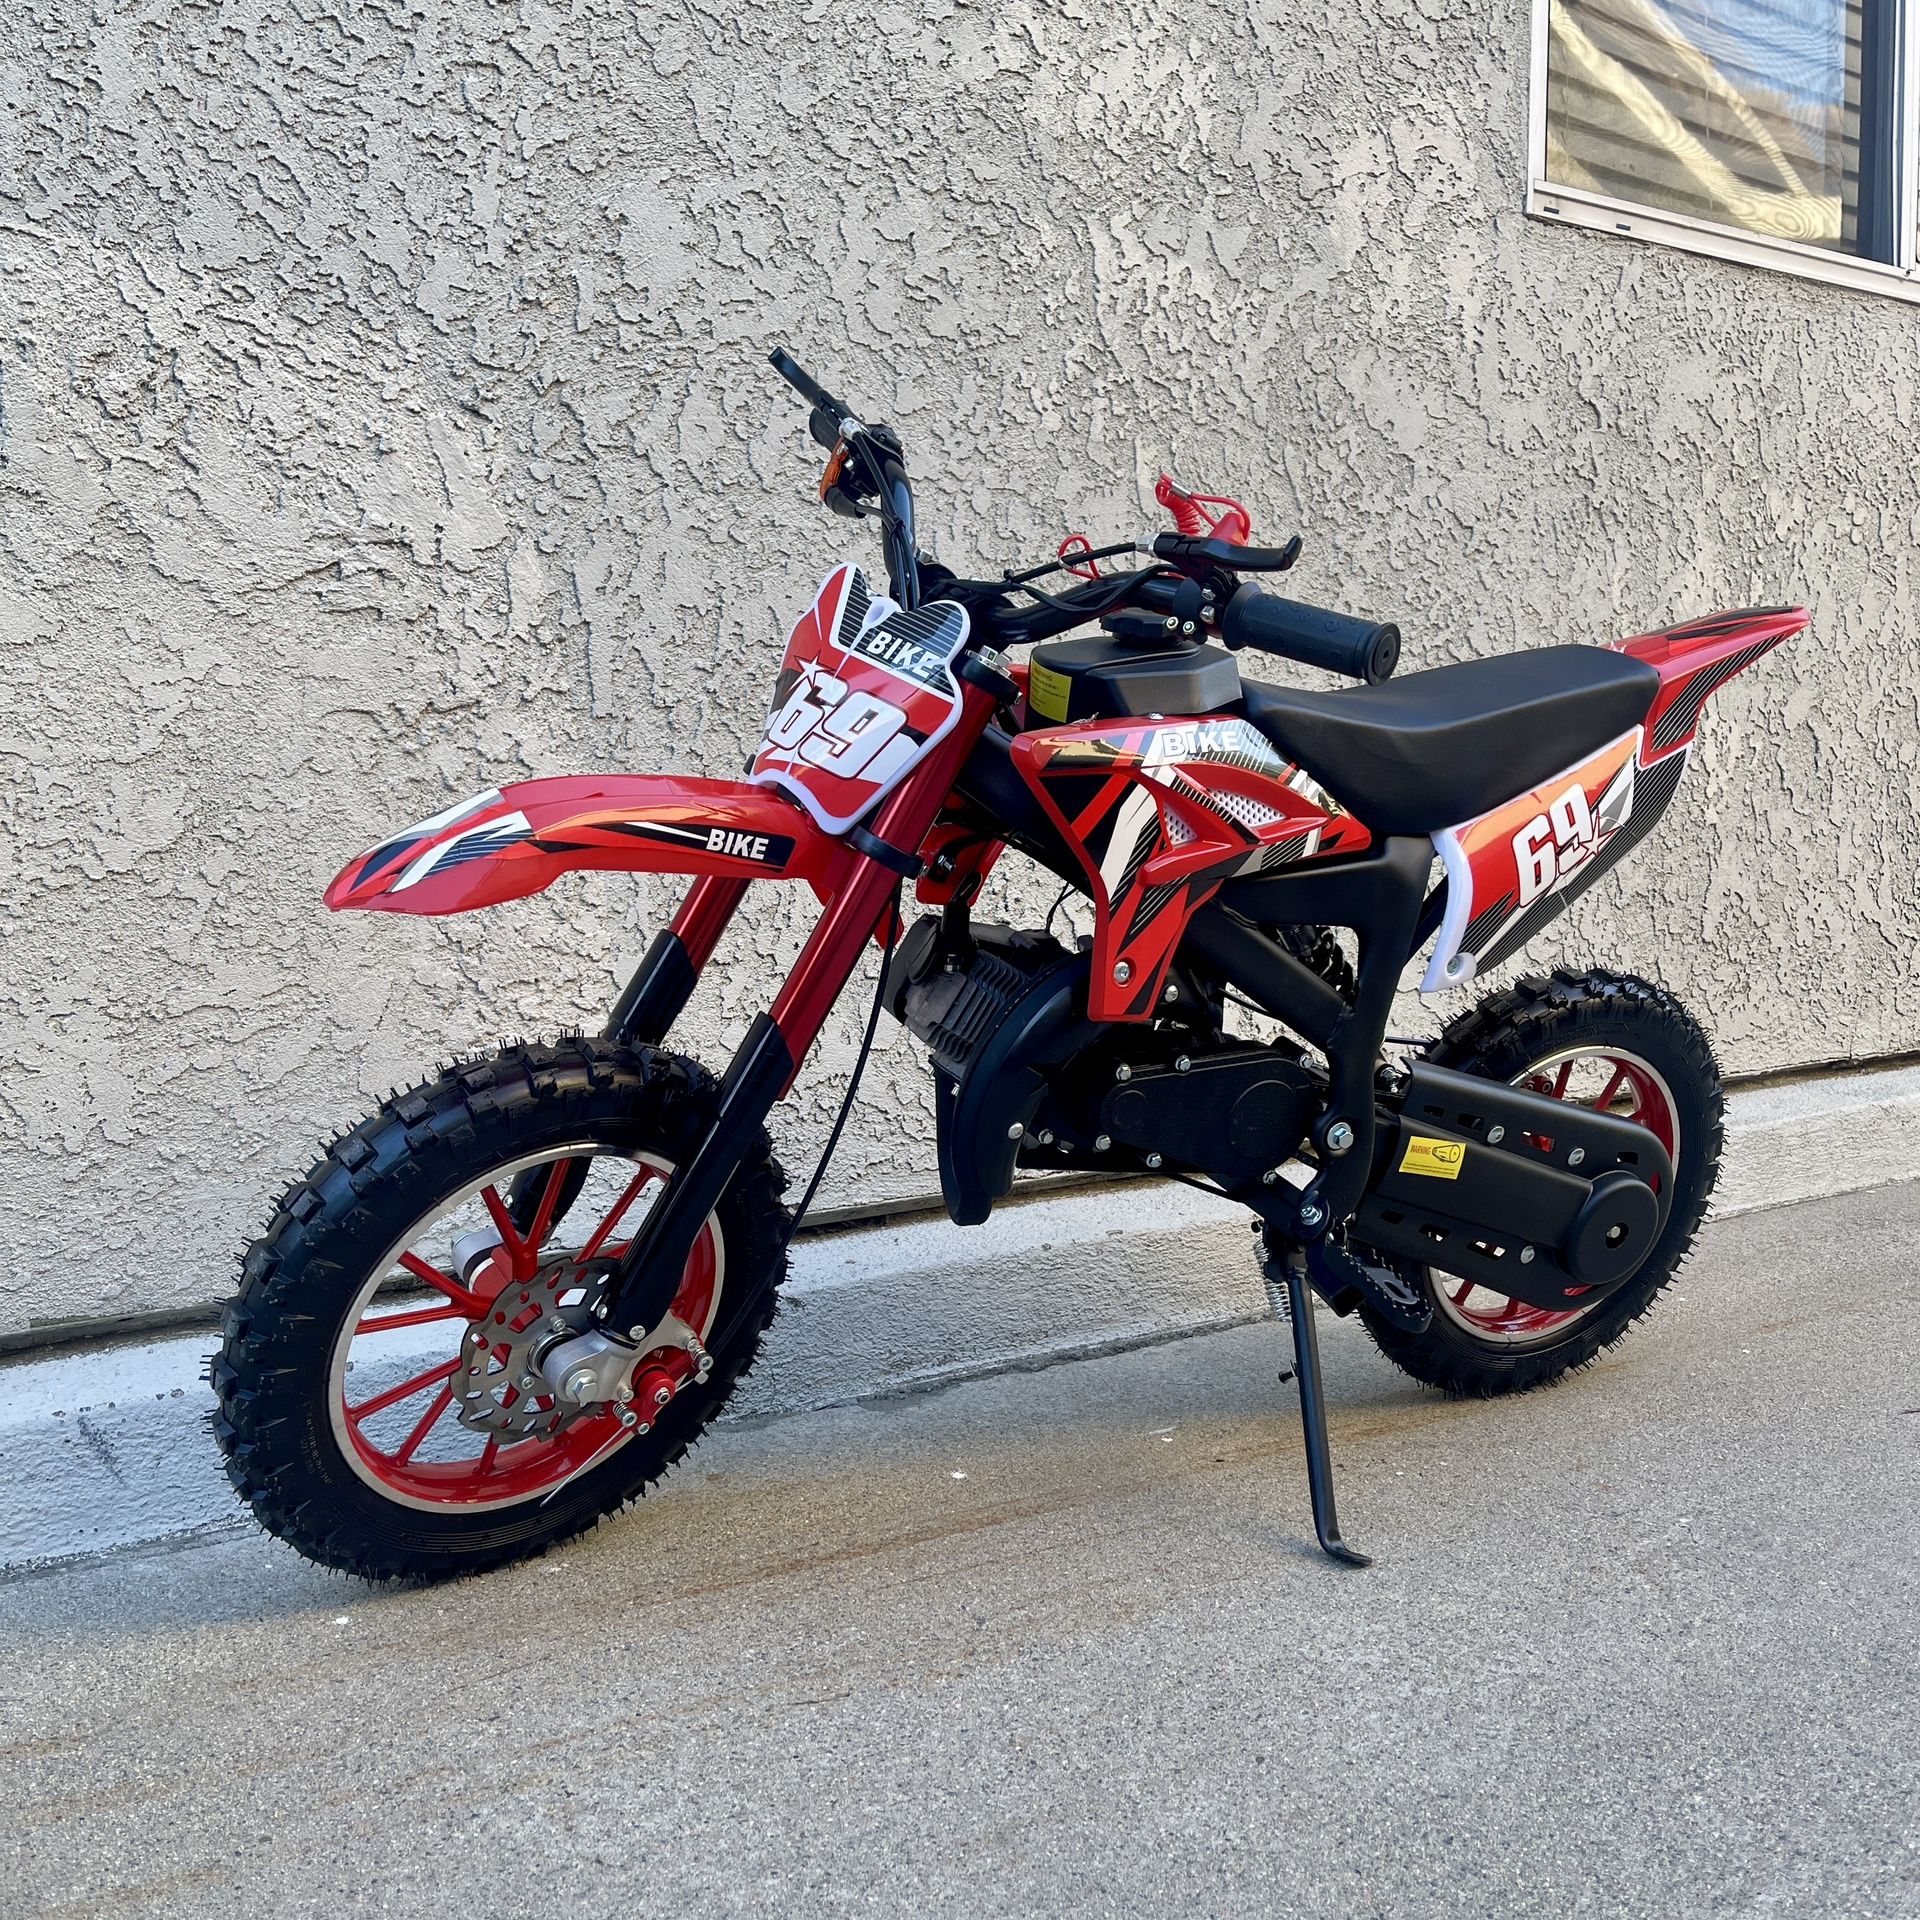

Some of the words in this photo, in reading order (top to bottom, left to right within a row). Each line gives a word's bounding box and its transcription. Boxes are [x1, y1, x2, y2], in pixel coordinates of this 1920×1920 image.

[866, 631, 942, 679] BIKE
[768, 671, 908, 780] 69
[1162, 730, 1241, 757] BIKE
[706, 828, 769, 860] BIKE
[1511, 783, 1593, 908] 69
